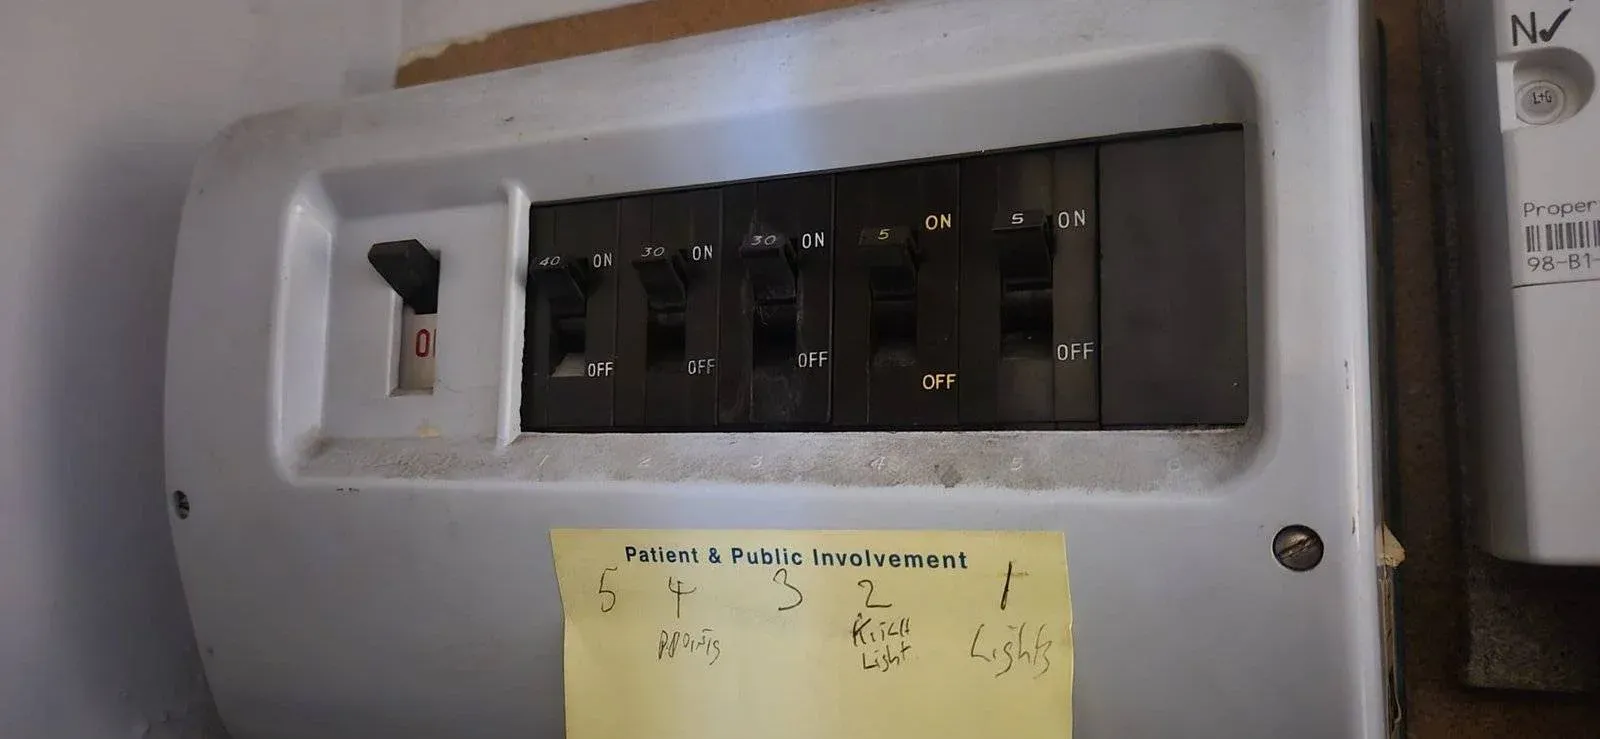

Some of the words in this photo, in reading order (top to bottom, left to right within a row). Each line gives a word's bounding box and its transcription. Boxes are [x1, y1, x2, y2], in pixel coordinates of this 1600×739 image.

[925, 213, 952, 231] ON
[1011, 213, 1024, 225] 5
[1058, 210, 1086, 229] ON
[751, 234, 777, 246] 30
[802, 232, 825, 249] ON
[878, 229, 890, 240] 5
[641, 246, 665, 257] 30
[692, 245, 713, 261] ON
[539, 255, 561, 267] 40
[593, 253, 613, 268] ON
[798, 351, 829, 369] OFF
[1057, 343, 1094, 361] OFF
[588, 361, 614, 378] OFF
[687, 358, 715, 375] OFF
[922, 374, 956, 390] OFF
[625, 545, 699, 566] Patient
[709, 547, 723, 565] &
[732, 547, 803, 567] Public
[813, 548, 969, 570] Involvement
[598, 567, 619, 613] 5
[669, 577, 697, 618] 4
[773, 568, 804, 611] 3
[858, 579, 893, 608] 2
[1000, 560, 1013, 611] 1
[862, 641, 912, 672] Light
[971, 623, 1052, 678] Lights
